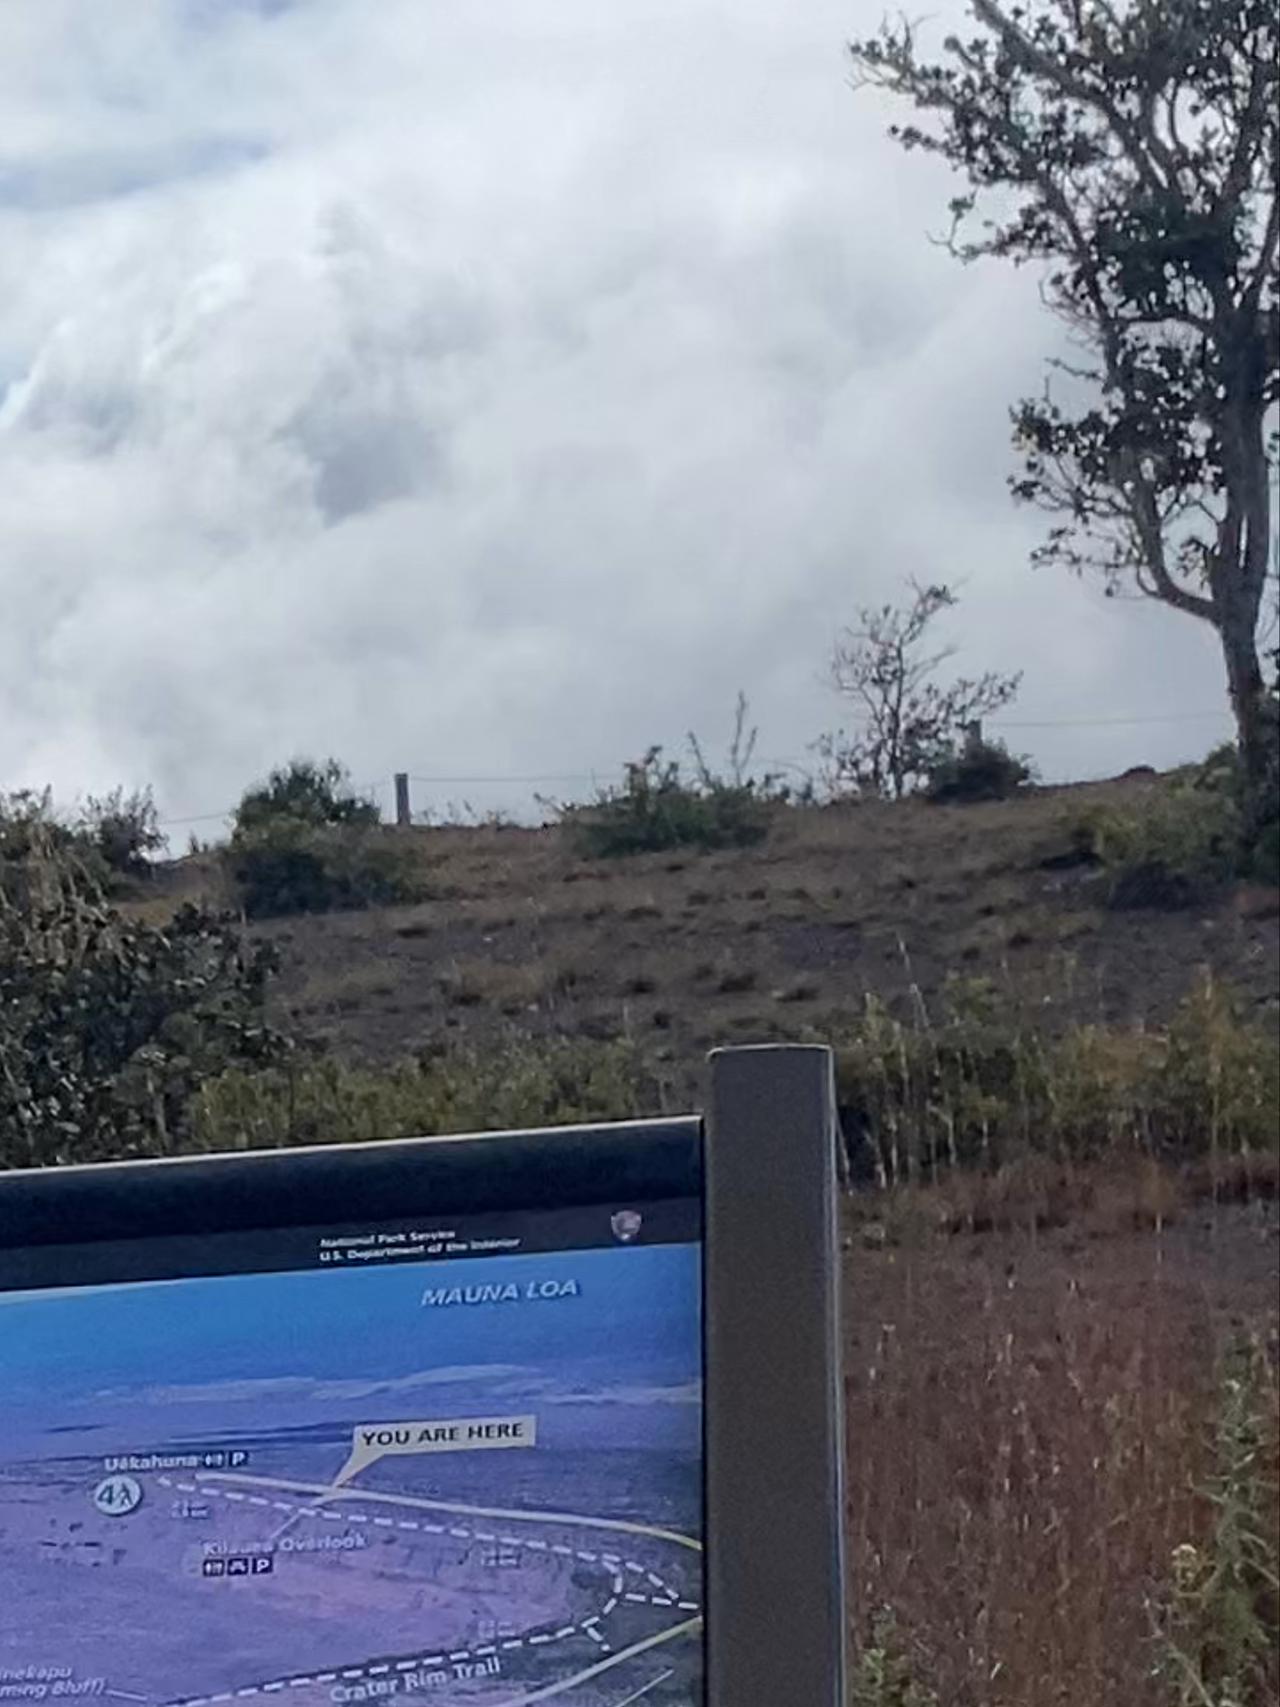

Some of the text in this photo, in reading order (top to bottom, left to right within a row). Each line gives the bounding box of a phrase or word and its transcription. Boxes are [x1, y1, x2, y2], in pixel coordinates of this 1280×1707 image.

[320, 1238, 520, 1262] U.S. Department of the Interior
[321, 1230, 455, 1249] National Park Service
[421, 1279, 579, 1307] MAUNA LOA
[361, 1421, 525, 1449] YOU ARE HERE
[97, 1484, 116, 1504] 4
[51, 1679, 105, 1697] Bluff)
[330, 1656, 501, 1703] Crater Rim Trail
